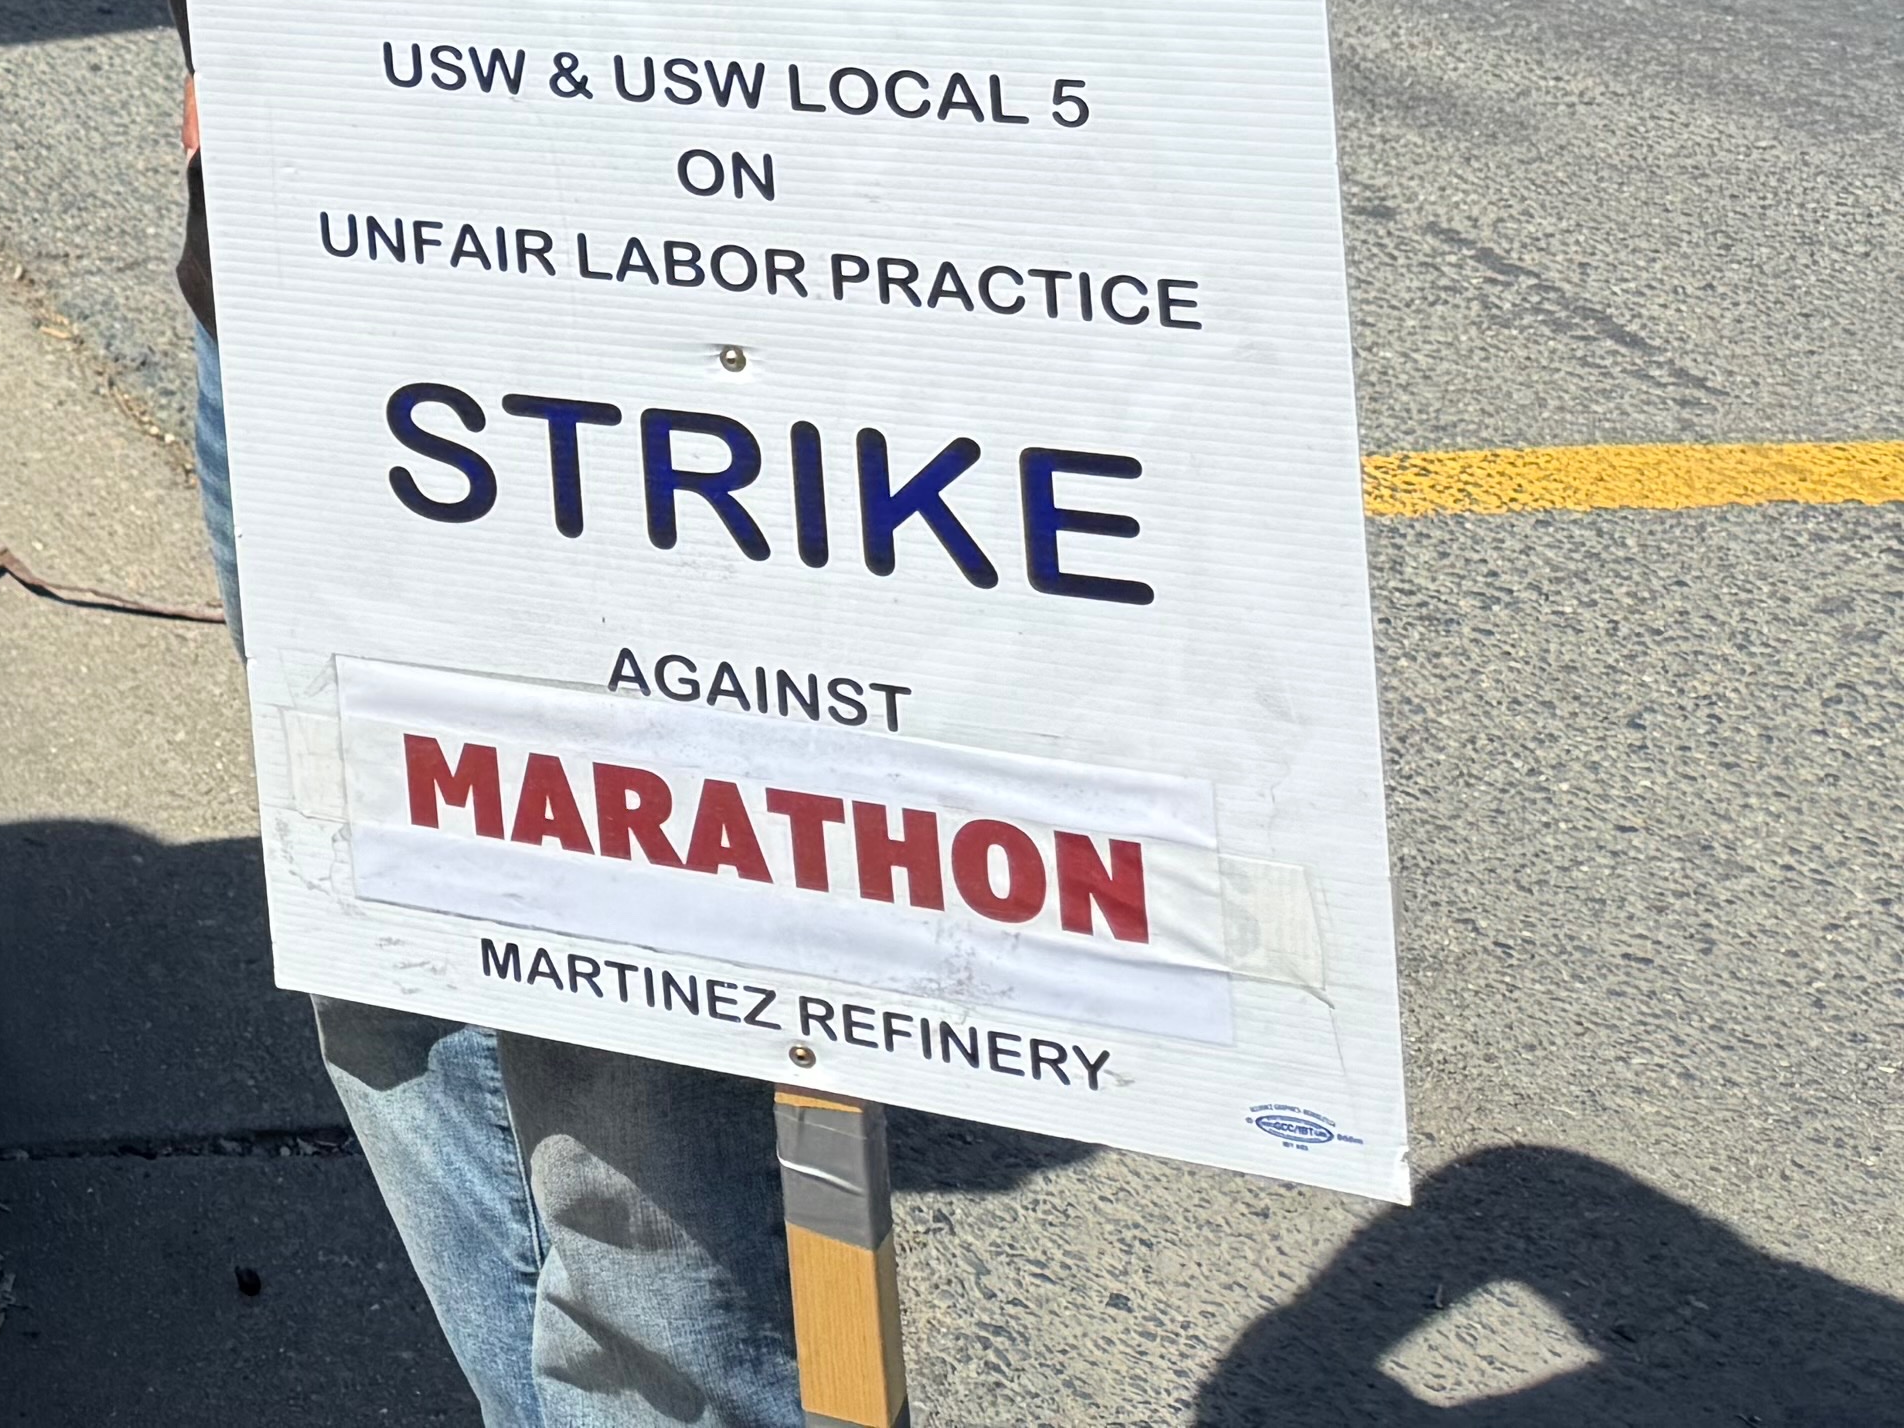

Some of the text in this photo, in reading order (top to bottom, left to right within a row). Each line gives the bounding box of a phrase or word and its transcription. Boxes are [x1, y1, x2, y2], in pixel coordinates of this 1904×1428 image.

[381, 39, 1092, 128] USW & USW LOCAL 5
[675, 147, 777, 203] ON
[317, 210, 1205, 332] UNFAIR LABOR PRACTICE
[385, 381, 1156, 606] STRIKE
[605, 646, 913, 734] AGAINST
[403, 732, 1152, 945] MARATHON
[479, 936, 1113, 1093] MARTINEZ REFINERY
